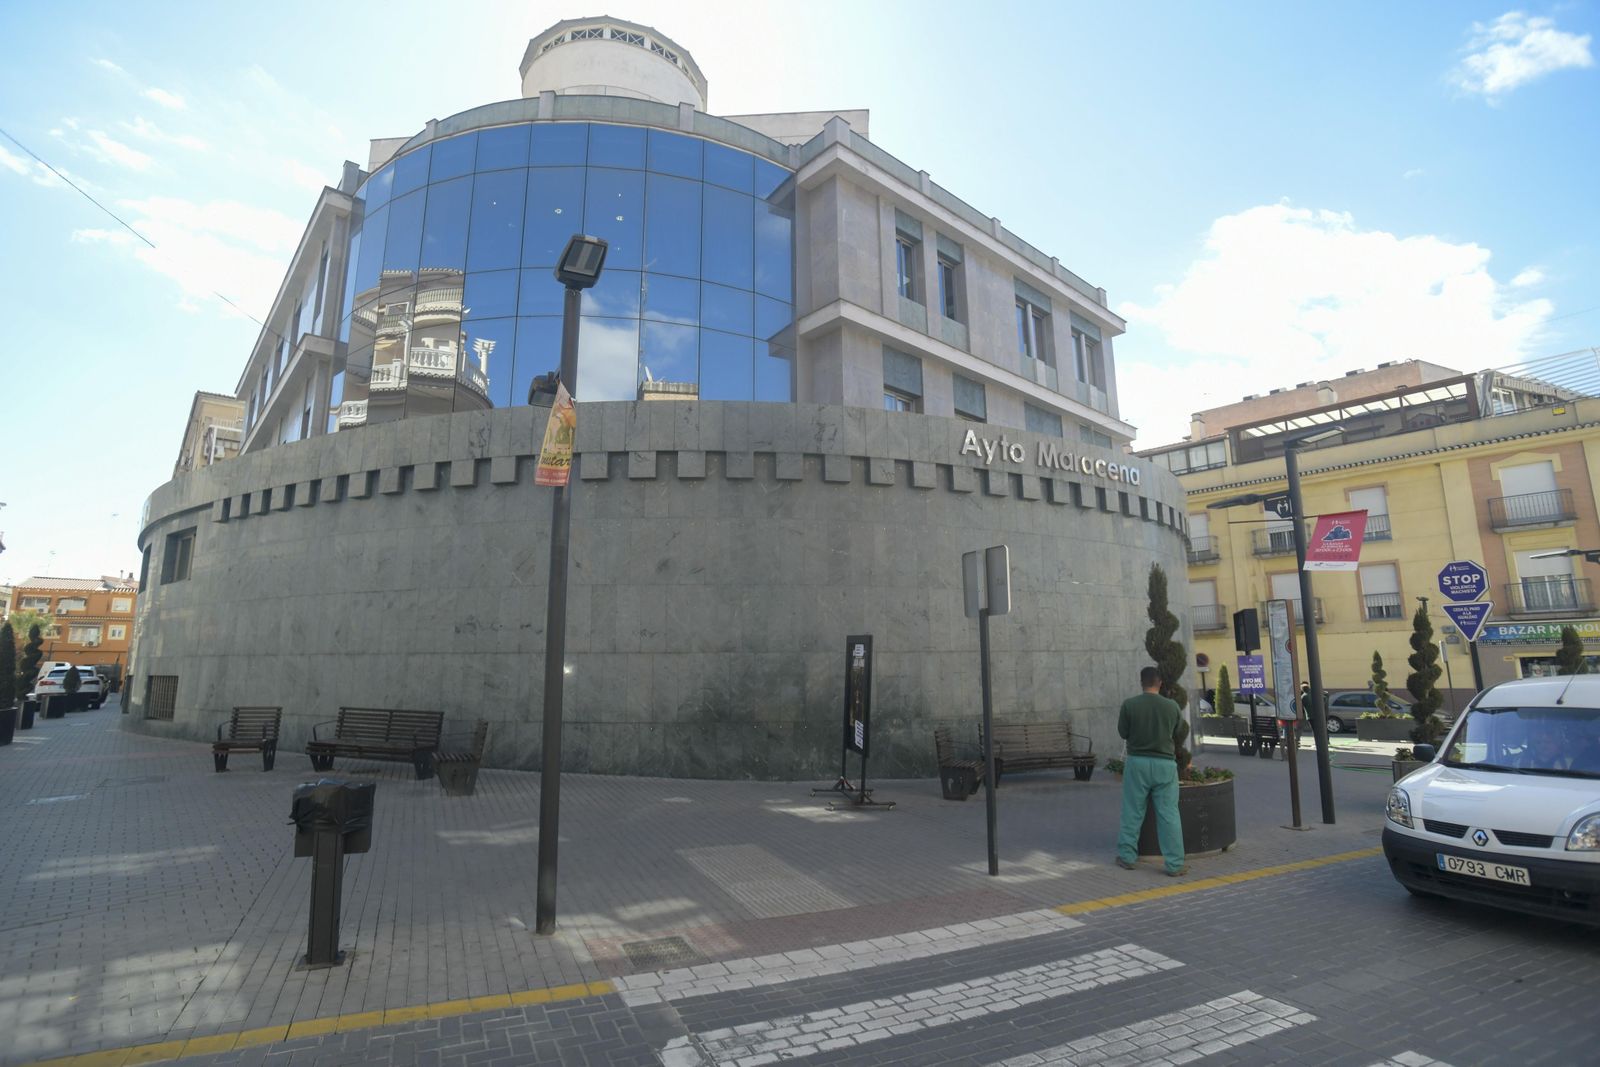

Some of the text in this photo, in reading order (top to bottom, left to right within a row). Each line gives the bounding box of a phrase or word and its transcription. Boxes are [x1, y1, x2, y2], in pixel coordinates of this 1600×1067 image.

[961, 429, 1141, 486] Ayto Maracena
[1443, 573, 1480, 585] STOP
[1498, 625, 1546, 635] BAZAR
[1448, 857, 1526, 883] 0793 CMR
